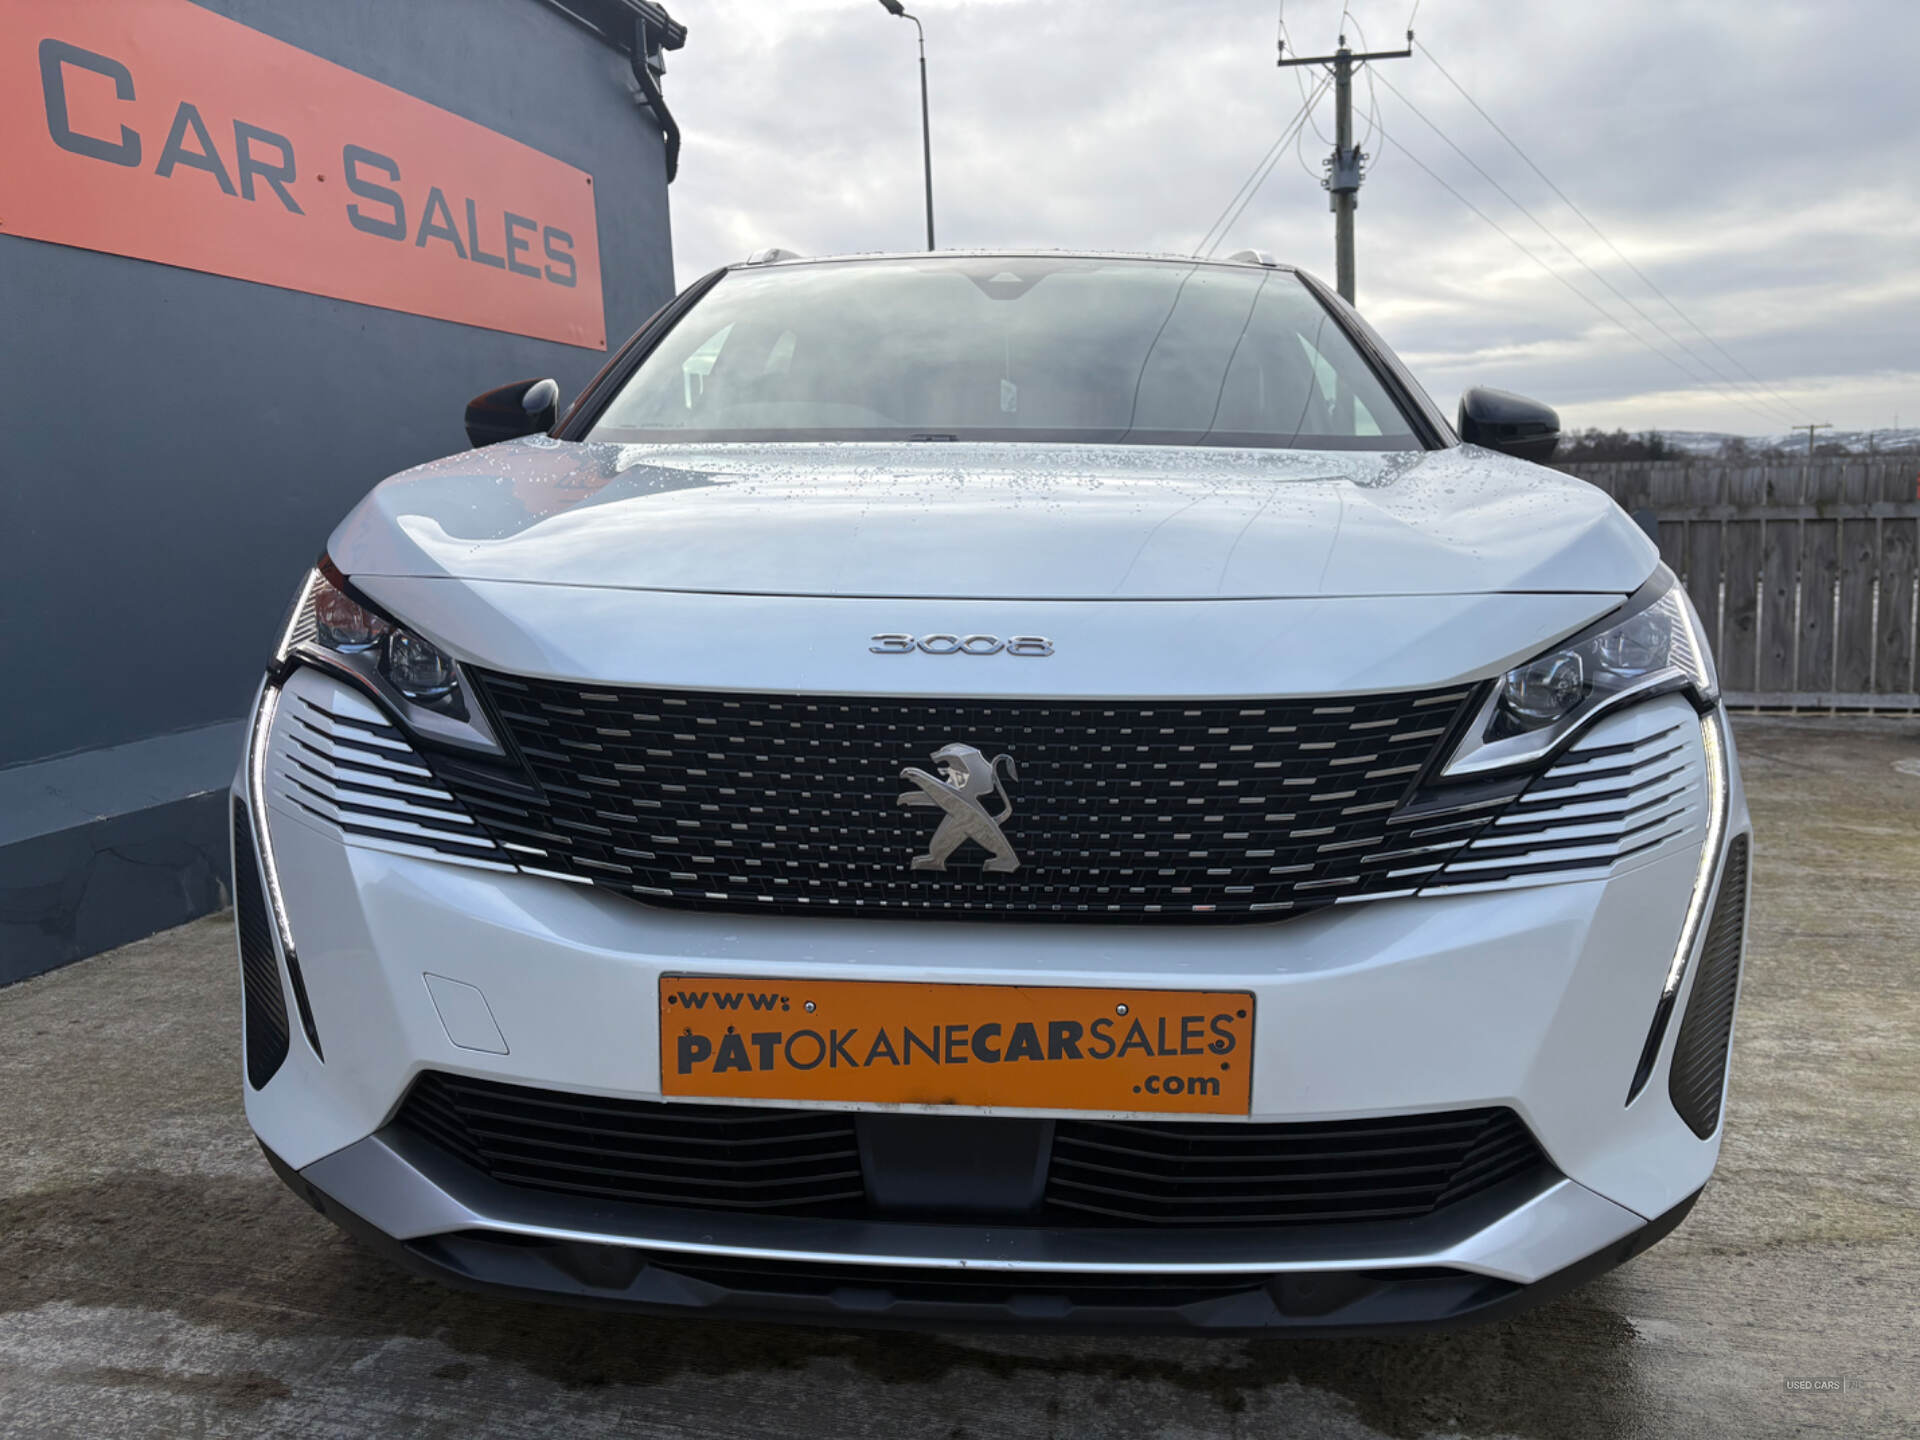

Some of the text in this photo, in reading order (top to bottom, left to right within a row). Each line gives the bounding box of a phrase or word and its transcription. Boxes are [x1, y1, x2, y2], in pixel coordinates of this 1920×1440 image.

[39, 38, 578, 288] CAR SALES
[868, 633, 1055, 657] 3008
[677, 1013, 1236, 1075] PATOKANECARSALES
[1132, 1073, 1221, 1097] .com
